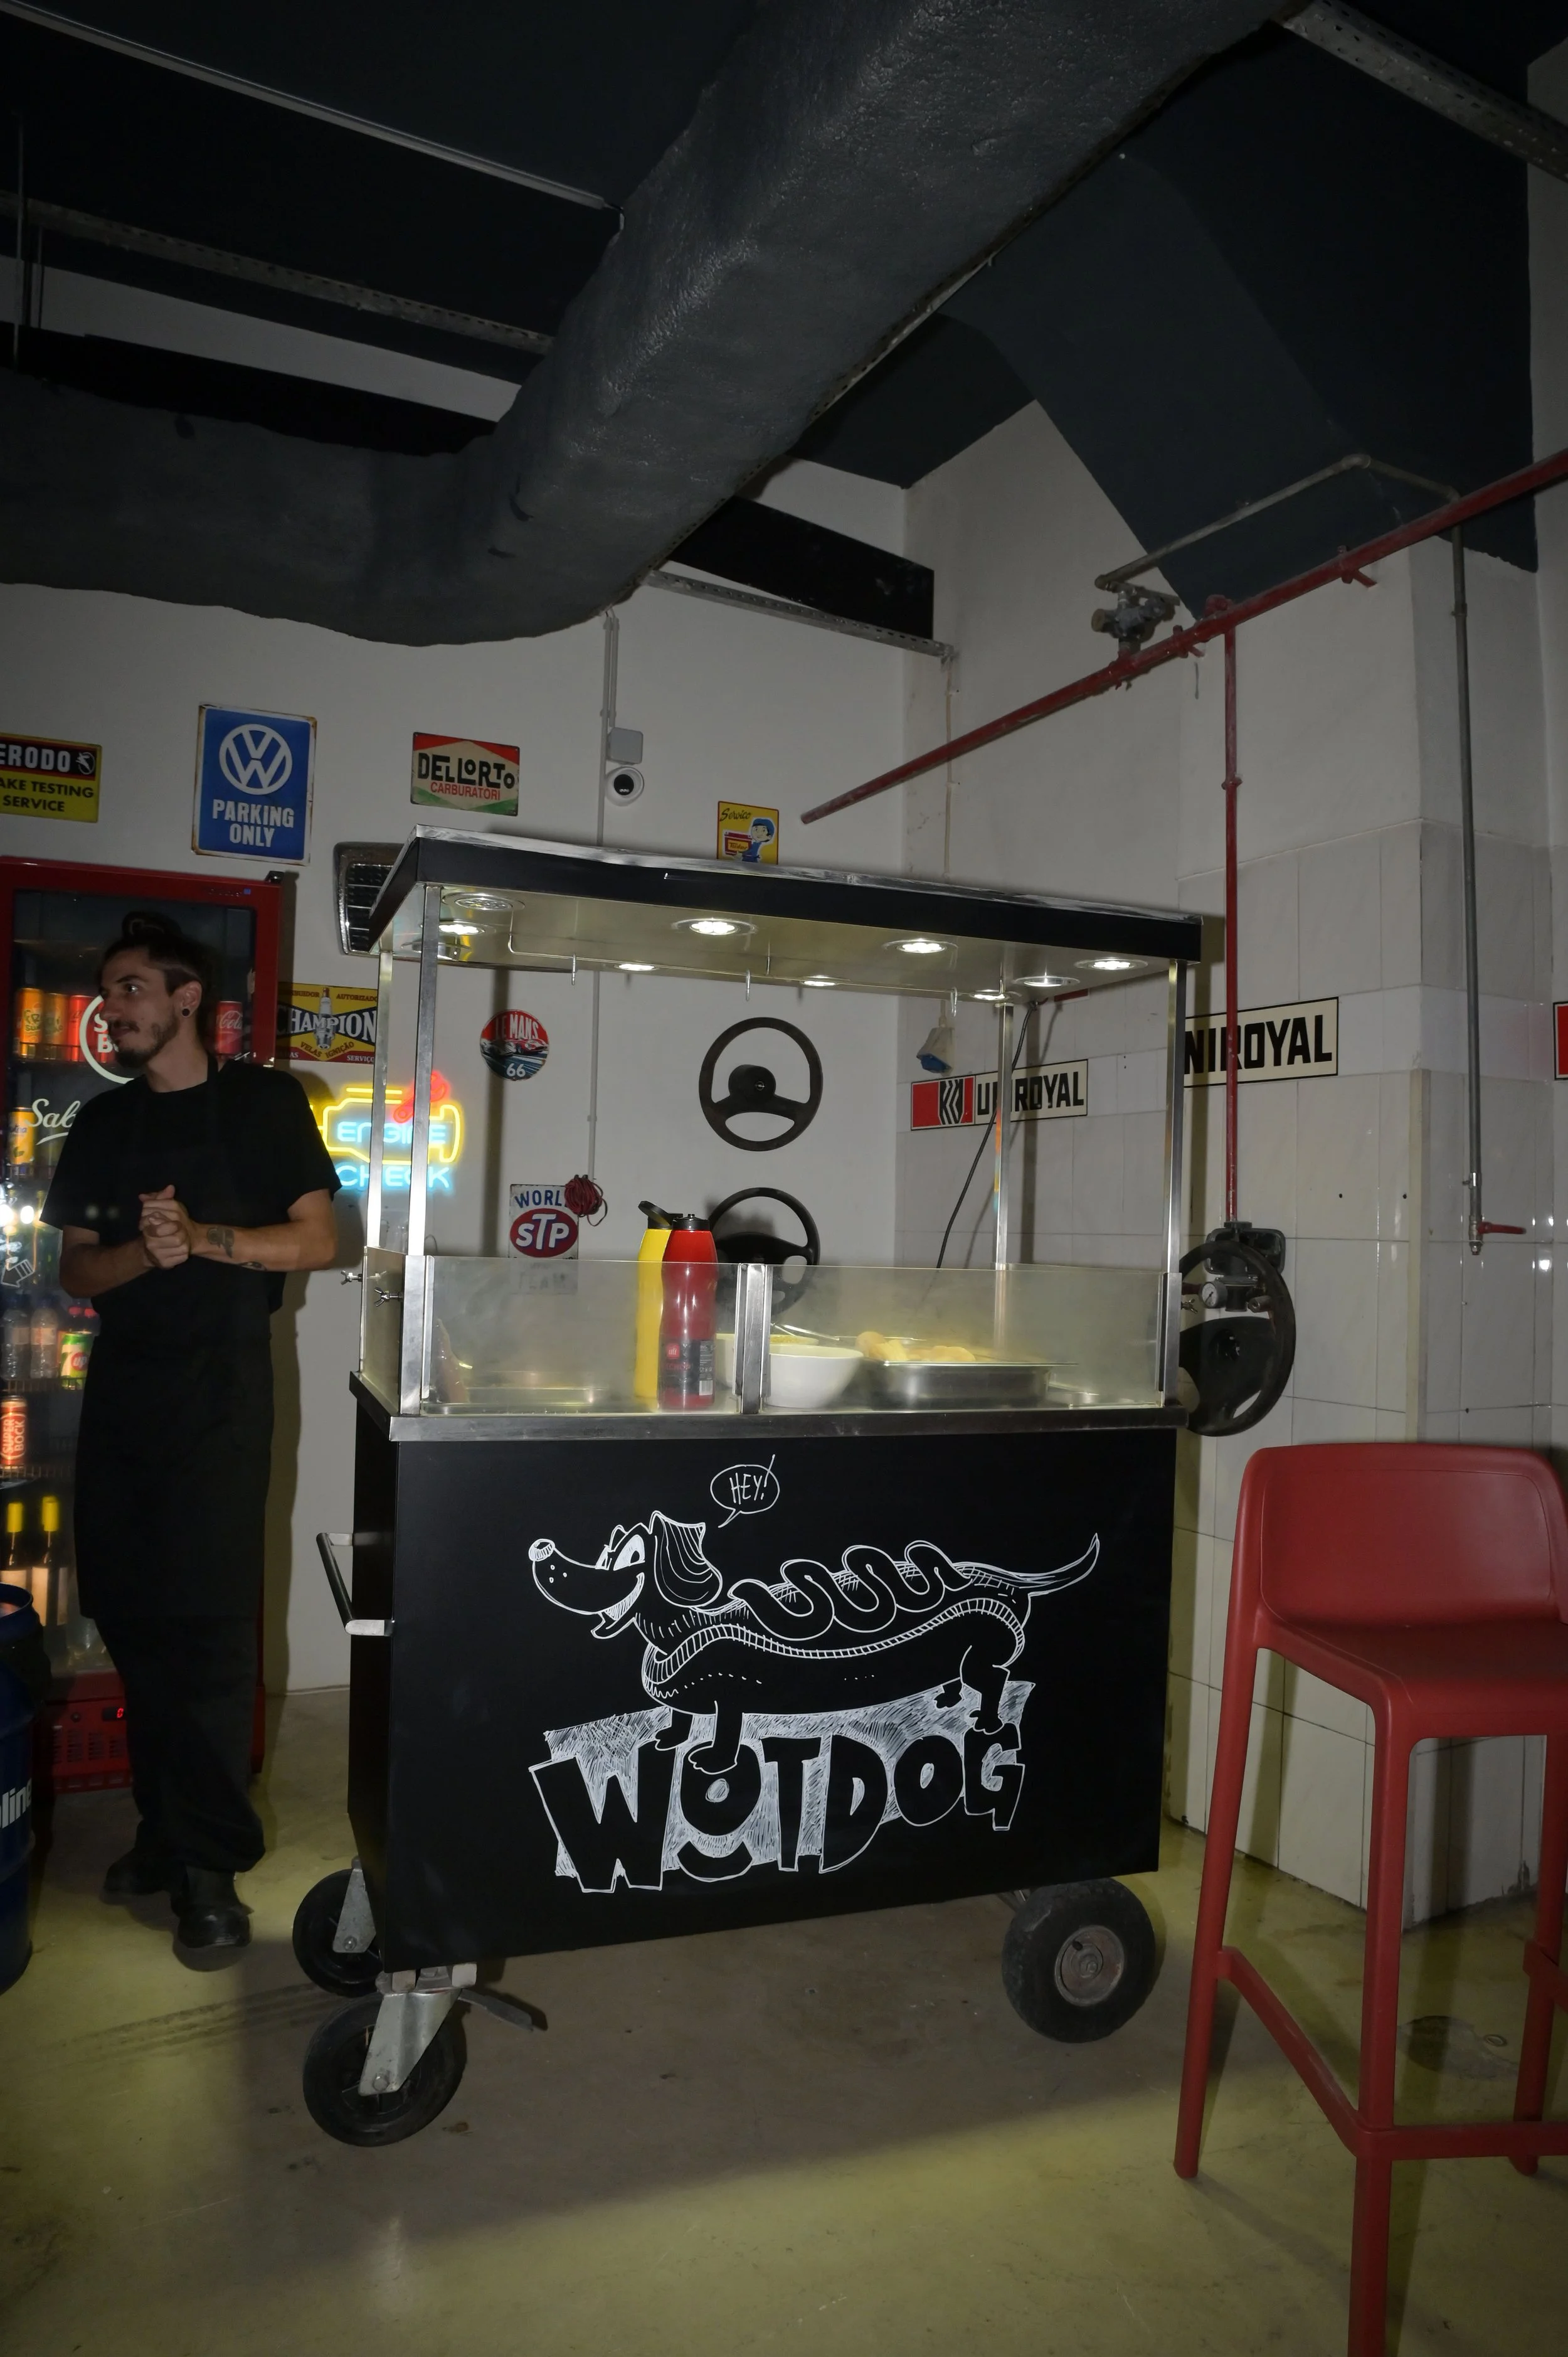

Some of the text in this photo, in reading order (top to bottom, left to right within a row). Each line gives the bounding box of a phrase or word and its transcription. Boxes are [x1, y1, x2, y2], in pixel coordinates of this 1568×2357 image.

[226, 726, 287, 792] VW
[417, 752, 515, 789] DELLORTO
[3, 795, 65, 812] SERVICE
[31, 781, 93, 798] TESTING
[430, 782, 501, 801] CARBURATORI
[212, 799, 295, 828] PARKING
[229, 824, 275, 848] ONLY
[495, 1013, 539, 1040] LE MANS
[300, 1041, 322, 1058] VELAS
[325, 1040, 355, 1058] IGNIÇÃO
[506, 1063, 526, 1077] 66
[978, 1072, 1084, 1115] UROYAL
[514, 1189, 567, 1209] WORL
[516, 1213, 569, 1250] STP
[2, 1417, 14, 1454] SUPER
[14, 1419, 26, 1452] BOCK
[729, 1454, 775, 1504] HEY!
[0, 1777, 33, 1829] line
